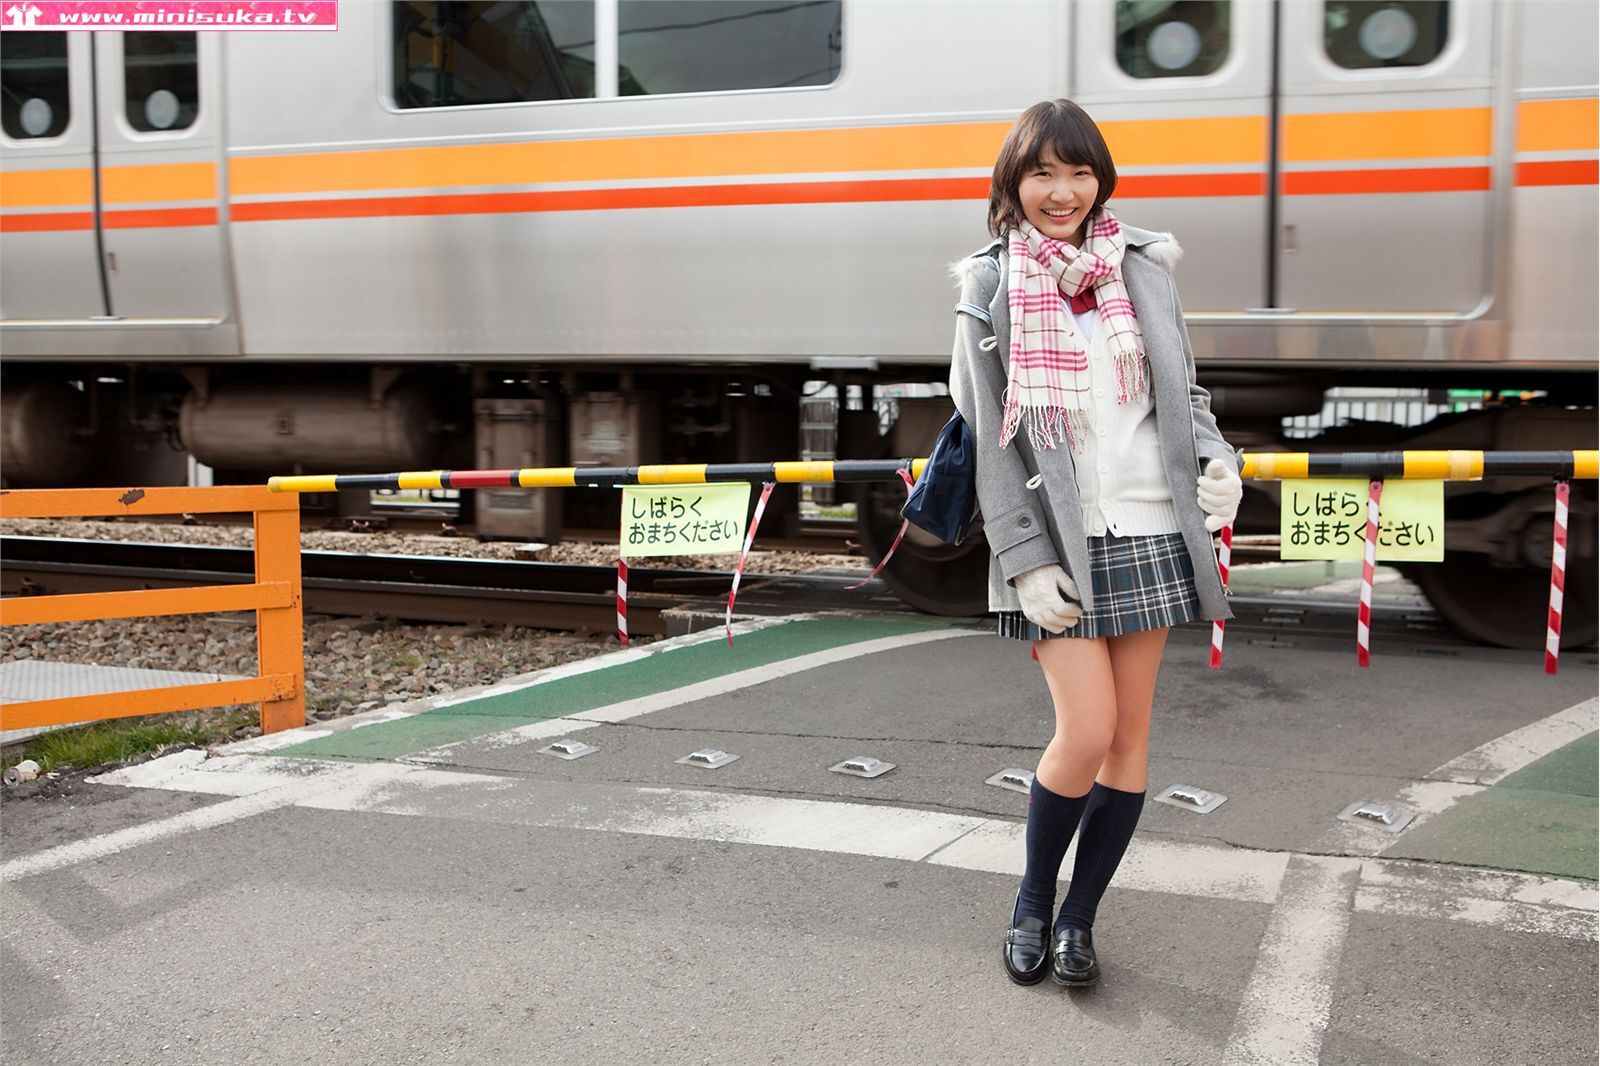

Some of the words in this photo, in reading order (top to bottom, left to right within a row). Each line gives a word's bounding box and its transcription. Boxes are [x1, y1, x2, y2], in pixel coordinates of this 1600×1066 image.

[632, 496, 702, 519] しばらく
[1293, 491, 1382, 517] しばら
[628, 519, 738, 544] おまちください
